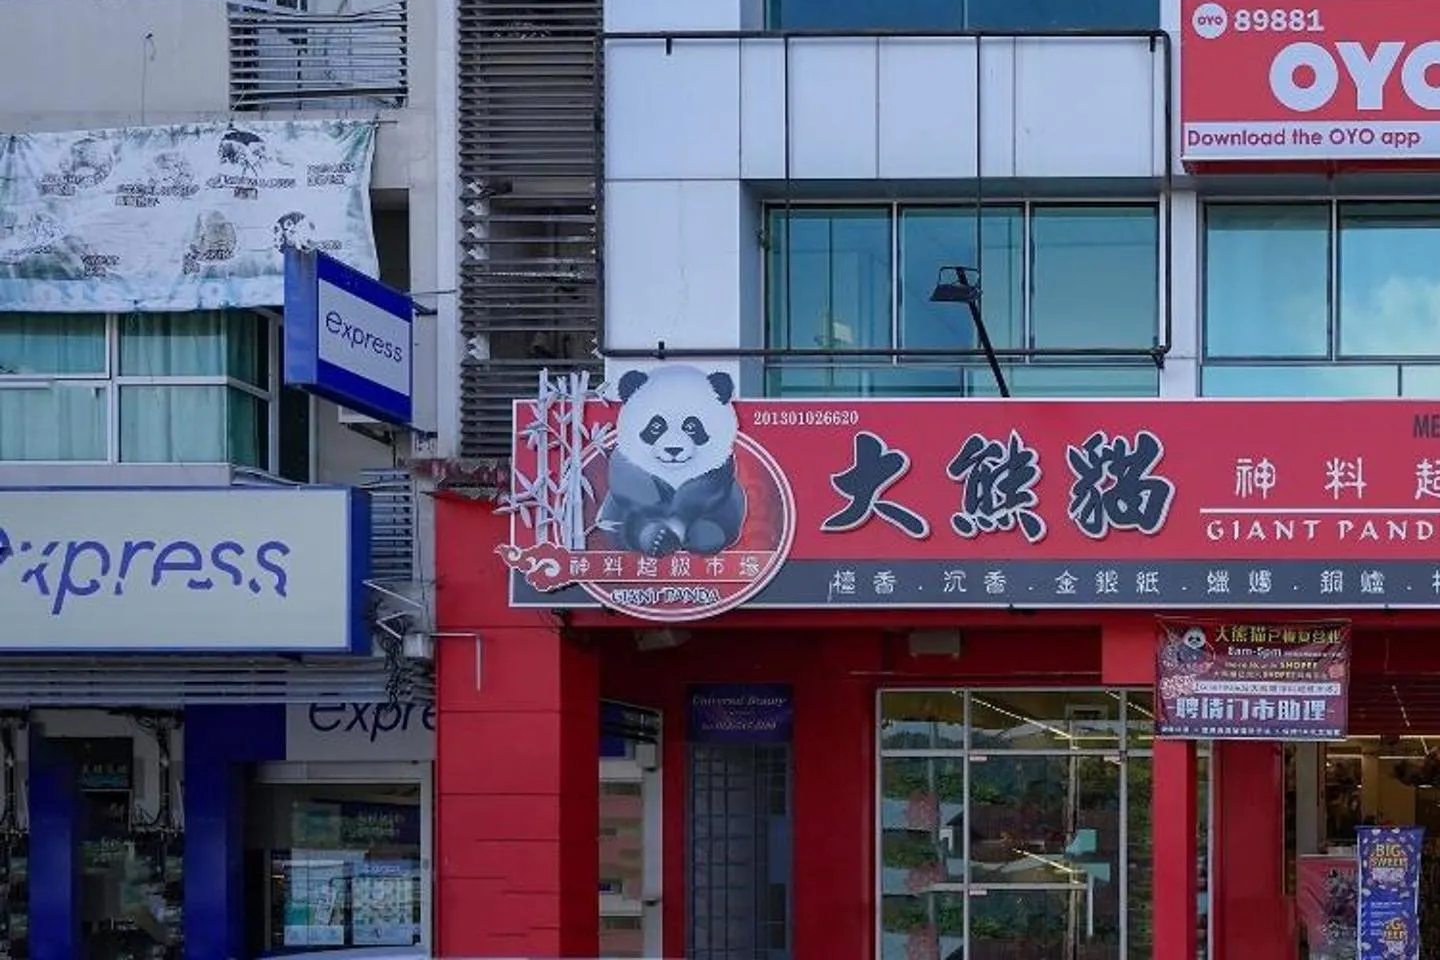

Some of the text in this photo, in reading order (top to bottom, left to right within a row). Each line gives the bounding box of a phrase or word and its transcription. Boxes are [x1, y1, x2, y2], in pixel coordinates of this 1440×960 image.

[1197, 8, 1325, 32] OYO 89881
[1187, 128, 1421, 148] Download the OYO app
[325, 311, 403, 363] express
[752, 410, 860, 426] 201301026620
[820, 429, 1176, 542] 大熊貓
[1206, 518, 1323, 541] GIANT
[0, 526, 291, 616] xpress
[943, 570, 1009, 595] 沉香
[610, 588, 661, 605] GIANT
[1375, 843, 1402, 857] BIG
